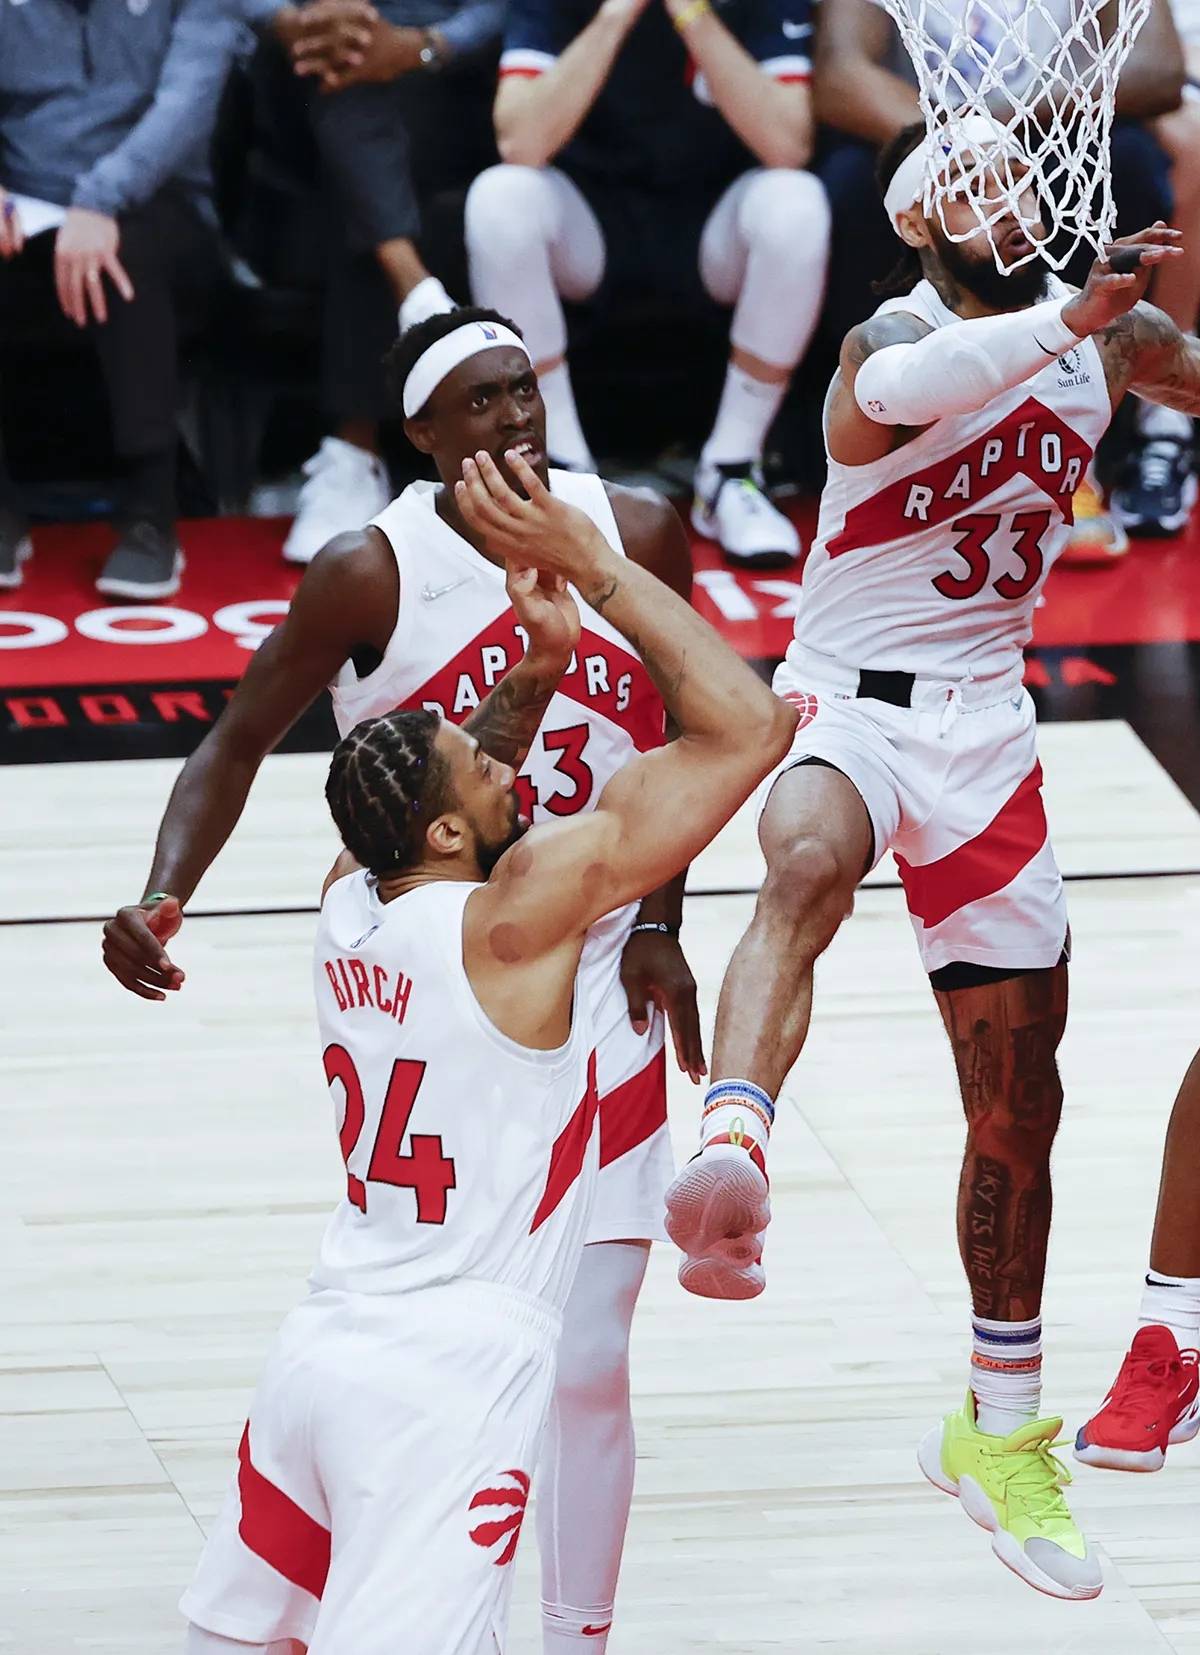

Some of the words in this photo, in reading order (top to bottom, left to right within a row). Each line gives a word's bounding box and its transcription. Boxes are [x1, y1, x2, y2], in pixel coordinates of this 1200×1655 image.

[1057, 376, 1075, 389] Sun
[1075, 373, 1091, 386] Life
[903, 421, 1082, 521] RAPTOR
[931, 509, 1052, 600] 33
[325, 958, 412, 1025] BIRCH
[322, 1043, 456, 1225] 24
